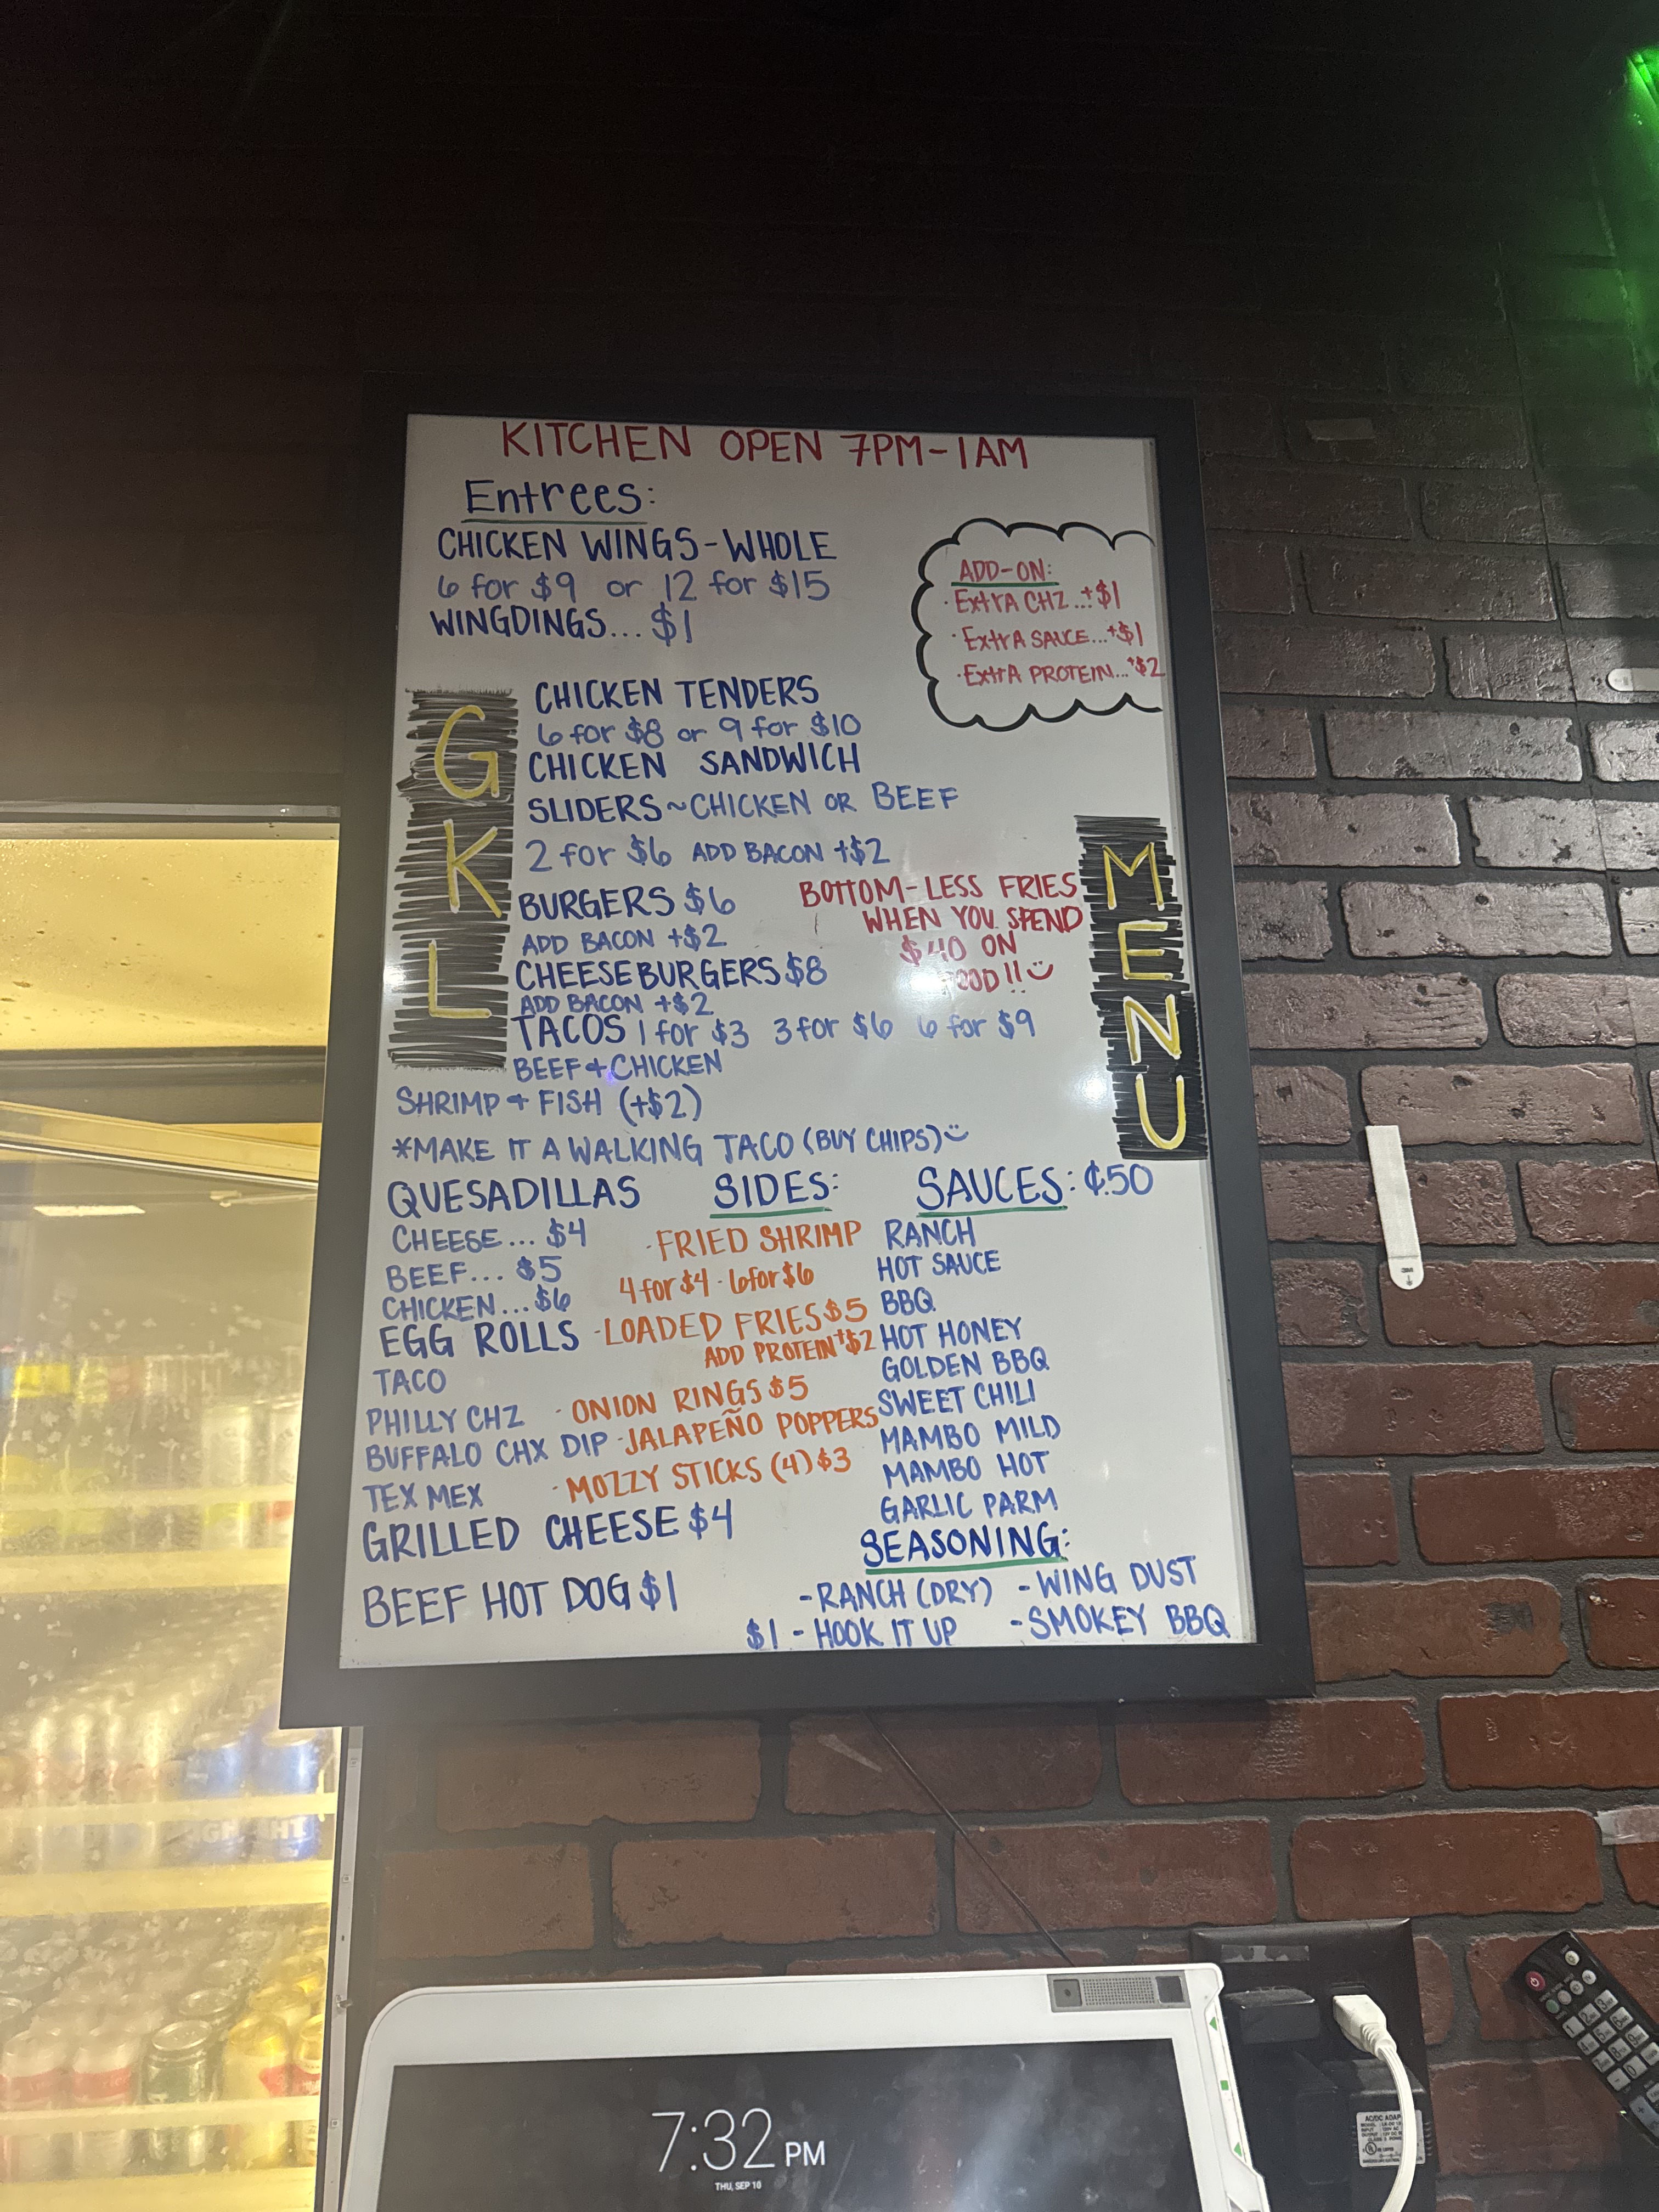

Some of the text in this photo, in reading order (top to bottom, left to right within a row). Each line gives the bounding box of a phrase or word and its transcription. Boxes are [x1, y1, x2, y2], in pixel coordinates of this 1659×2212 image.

[502, 421, 821, 463] KITCHEN OPEN
[465, 479, 654, 515] Entrees:
[438, 528, 567, 561] CHICKEN
[438, 569, 830, 603] 6 for $9 or 12 for $15
[960, 558, 1051, 582] ADD-ON:
[651, 601, 692, 647] $1
[535, 675, 819, 714] CHICKEN TENDERS
[538, 711, 861, 748] 6 for $8 or 9 for $10
[529, 742, 860, 783] CHICKEN SANDWICH
[825, 781, 958, 813] OR BEEF
[526, 834, 890, 872] 2 for $6 ADD BACON +$2
[519, 882, 736, 920] BURGERS $6
[998, 874, 1077, 900] FRIES
[862, 905, 1083, 934] WHEN YOU SPEND
[522, 924, 727, 956] ADD BACON +$2
[981, 930, 1017, 957] ON
[515, 951, 827, 990] CHEESEBURGERS $8
[521, 992, 714, 1015] ADD BACON +$2
[511, 1009, 1035, 1049] TACOS for $3 3 for $6 6 for $9
[514, 1049, 722, 1082] BEEF CHICKEN
[396, 1084, 702, 1127] SHRIMP FISH (+$2)
[509, 1124, 942, 1167] IT A WALKING TACO (BUY CHIPS)
[388, 1175, 640, 1218] QUESADILLAS
[714, 1170, 839, 1209] SIDES:
[917, 1166, 1076, 1210] SAUCES:
[546, 1218, 586, 1248] $4
[656, 1220, 861, 1261] FRIED SHRIMP
[884, 1217, 976, 1250] RANCH
[516, 1256, 562, 1283] $5
[877, 1250, 1001, 1283] HOT SAUCE
[535, 1284, 571, 1312] $6
[881, 1286, 936, 1316] BBQ
[379, 1320, 579, 1359] EGG ROLLS
[605, 1297, 868, 1345] LOADED FRIES $5
[879, 1317, 1022, 1351] HOT HONEY
[704, 1345, 744, 1369] ADD
[753, 1335, 838, 1364] PROTEIN
[882, 1346, 1049, 1383] GOLDEN BBQ
[373, 1369, 446, 1395] TACO
[572, 1375, 808, 1424] ONION RINGS $5
[878, 1378, 1035, 1417] SWEET CHILI
[366, 1404, 525, 1437] PHILLY CHZ
[624, 1406, 879, 1455] JALAPEÑO POPPERS
[880, 1414, 1061, 1454] MAMBO MILD
[365, 1432, 608, 1471] BUFFALO CHX DIP
[882, 1450, 1049, 1489] MAMBO HOT
[566, 1447, 851, 1504] MOZZY STICKS (4) $3
[362, 1482, 483, 1511] TEX MEX
[881, 1487, 1058, 1525] GARLIC PARM
[362, 1499, 732, 1562] GRILLED CHEESE $4
[860, 1523, 1070, 1568] SEASONING:
[1129, 1555, 1197, 1592] DUST
[363, 1570, 677, 1628] BEEF HOT DOG $1
[917, 1577, 992, 1609] (DRY)
[747, 1616, 958, 1652] $1 HOOK IT UP
[1165, 1603, 1232, 1639] BBQ
[652, 2108, 826, 2172] 7:32 PM
[715, 2181, 762, 2191] THU, SEP 10
